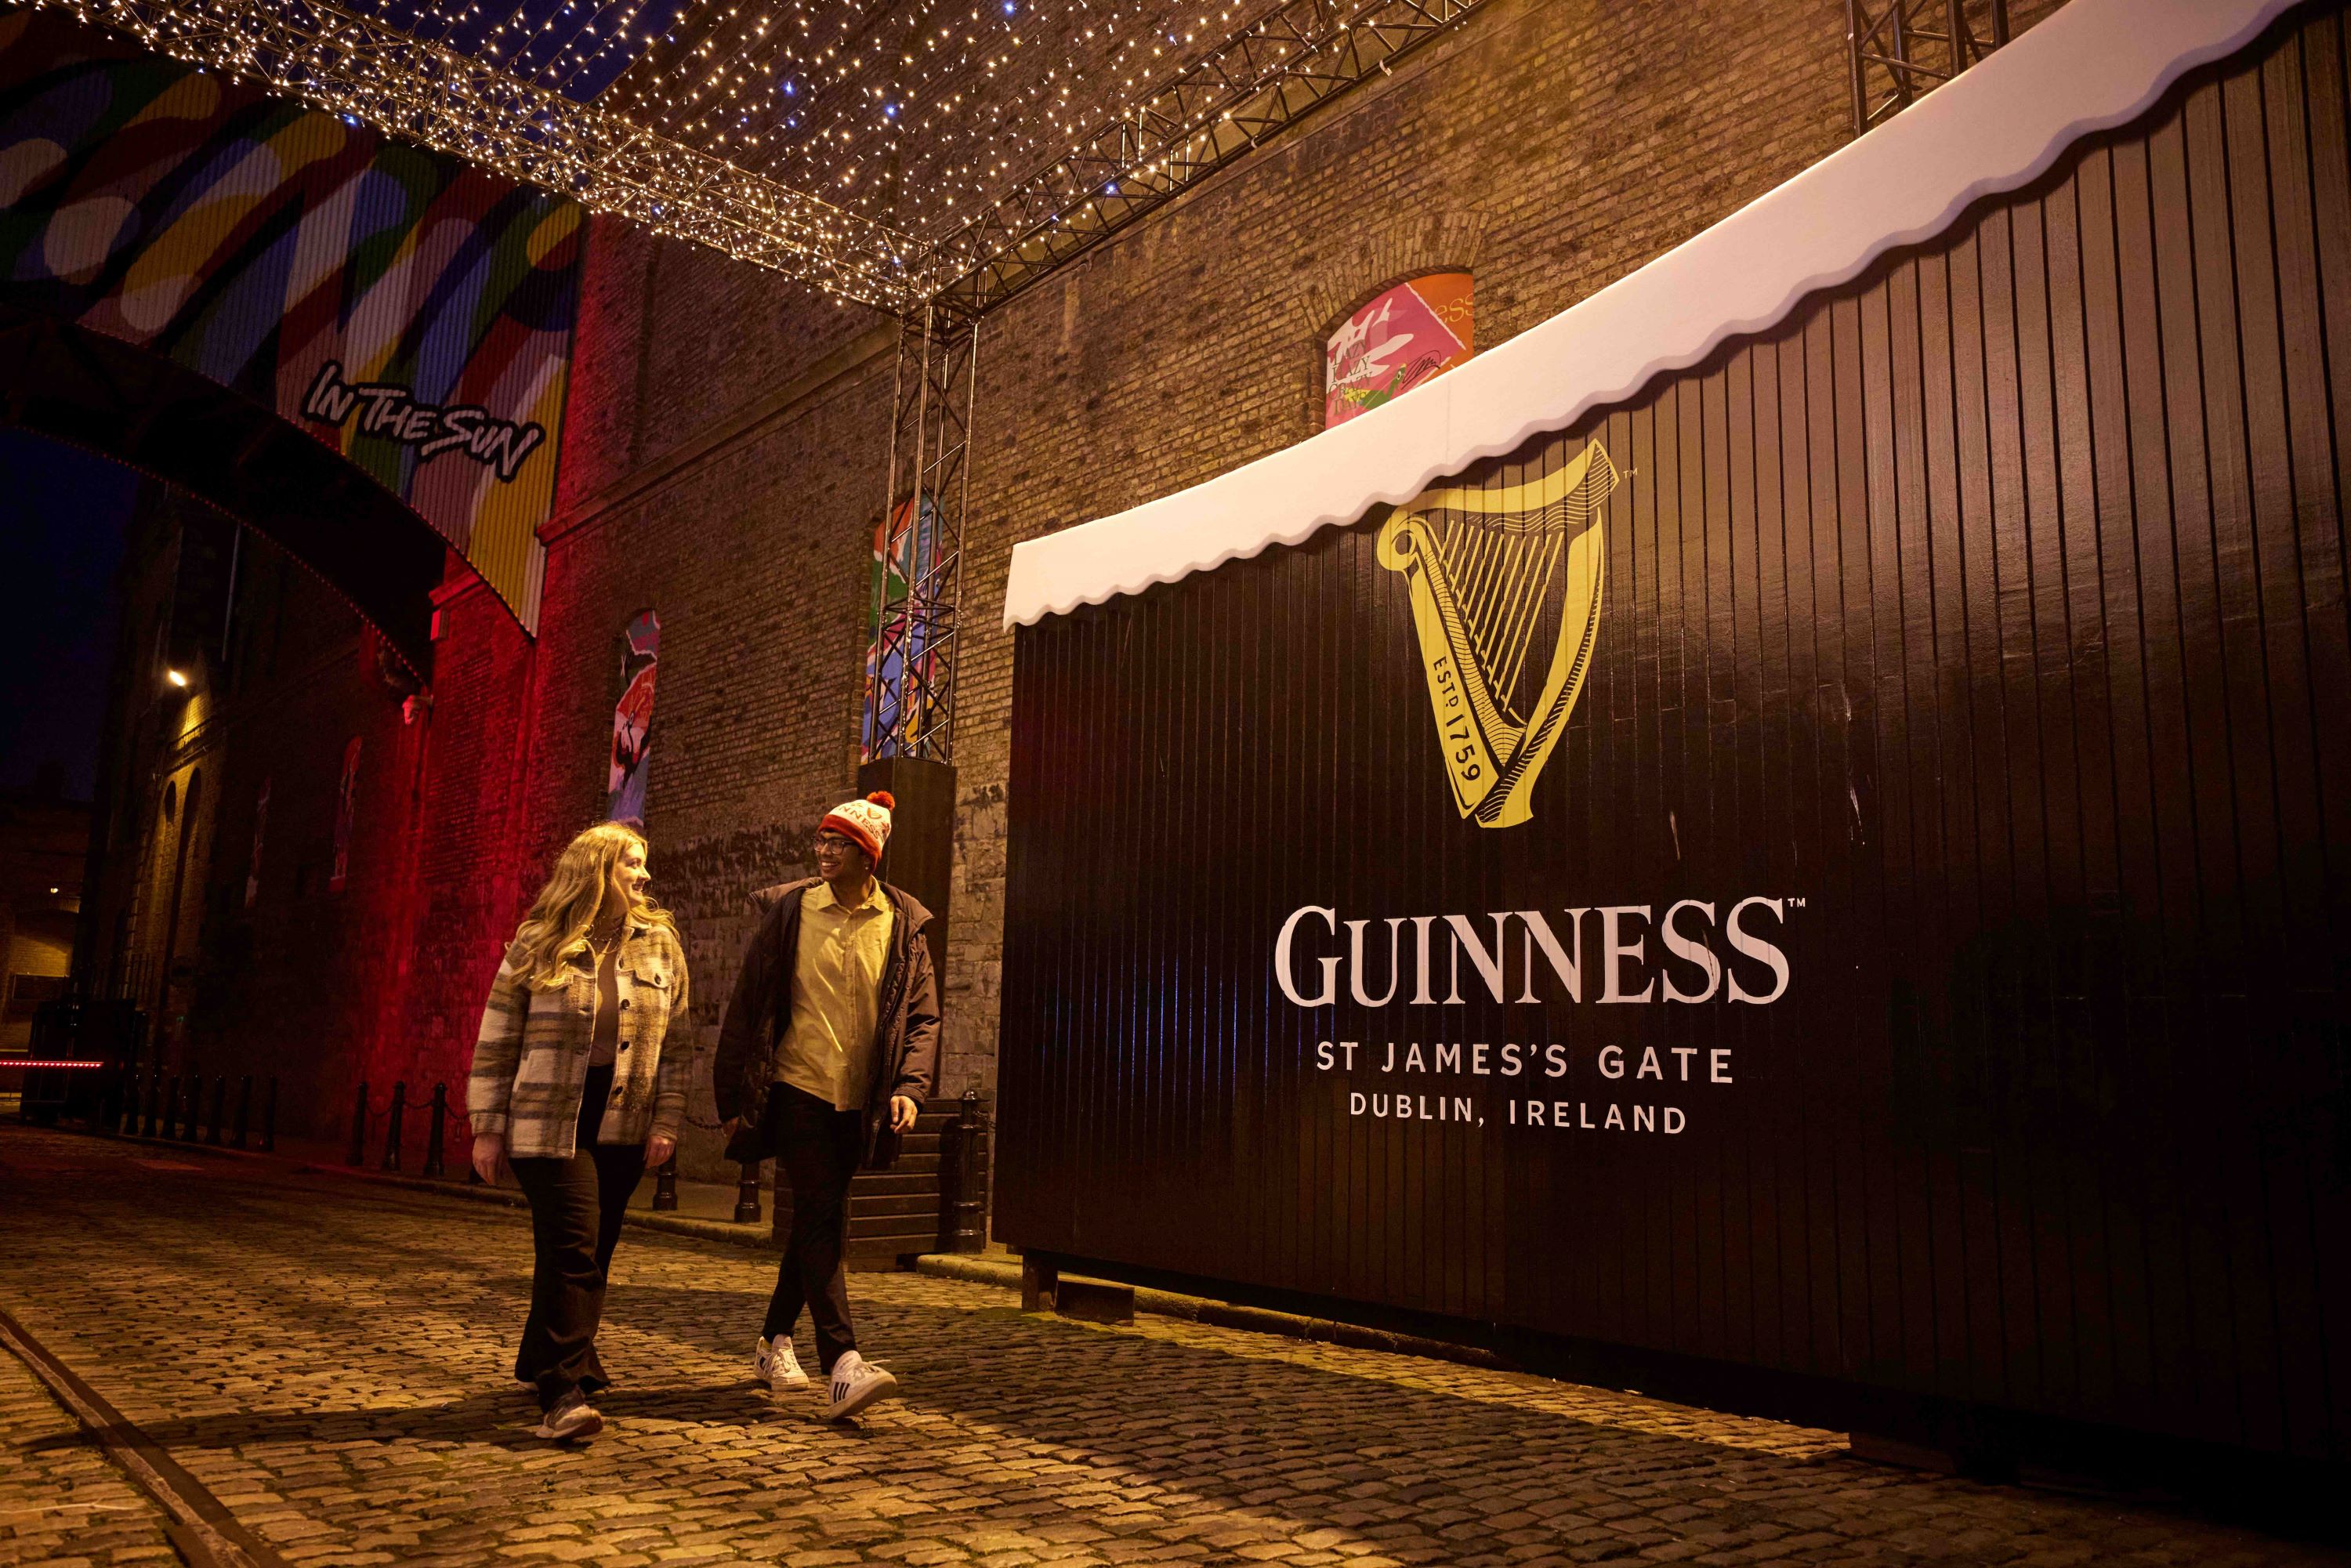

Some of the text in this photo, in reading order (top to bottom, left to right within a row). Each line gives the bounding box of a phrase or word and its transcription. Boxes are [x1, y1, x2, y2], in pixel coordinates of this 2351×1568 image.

[1331, 355, 1370, 384] HAZY
[1332, 339, 1366, 368] LAZY
[1328, 371, 1373, 401] CRAZY
[357, 387, 438, 440] THE
[1446, 714, 1481, 781] 1759
[1274, 896, 1806, 1008] GUINNESS TM
[1317, 1041, 1359, 1071] ST
[1598, 1045, 1733, 1084] GATE
[1350, 1092, 1686, 1135] DUBLIN, IRELAND
